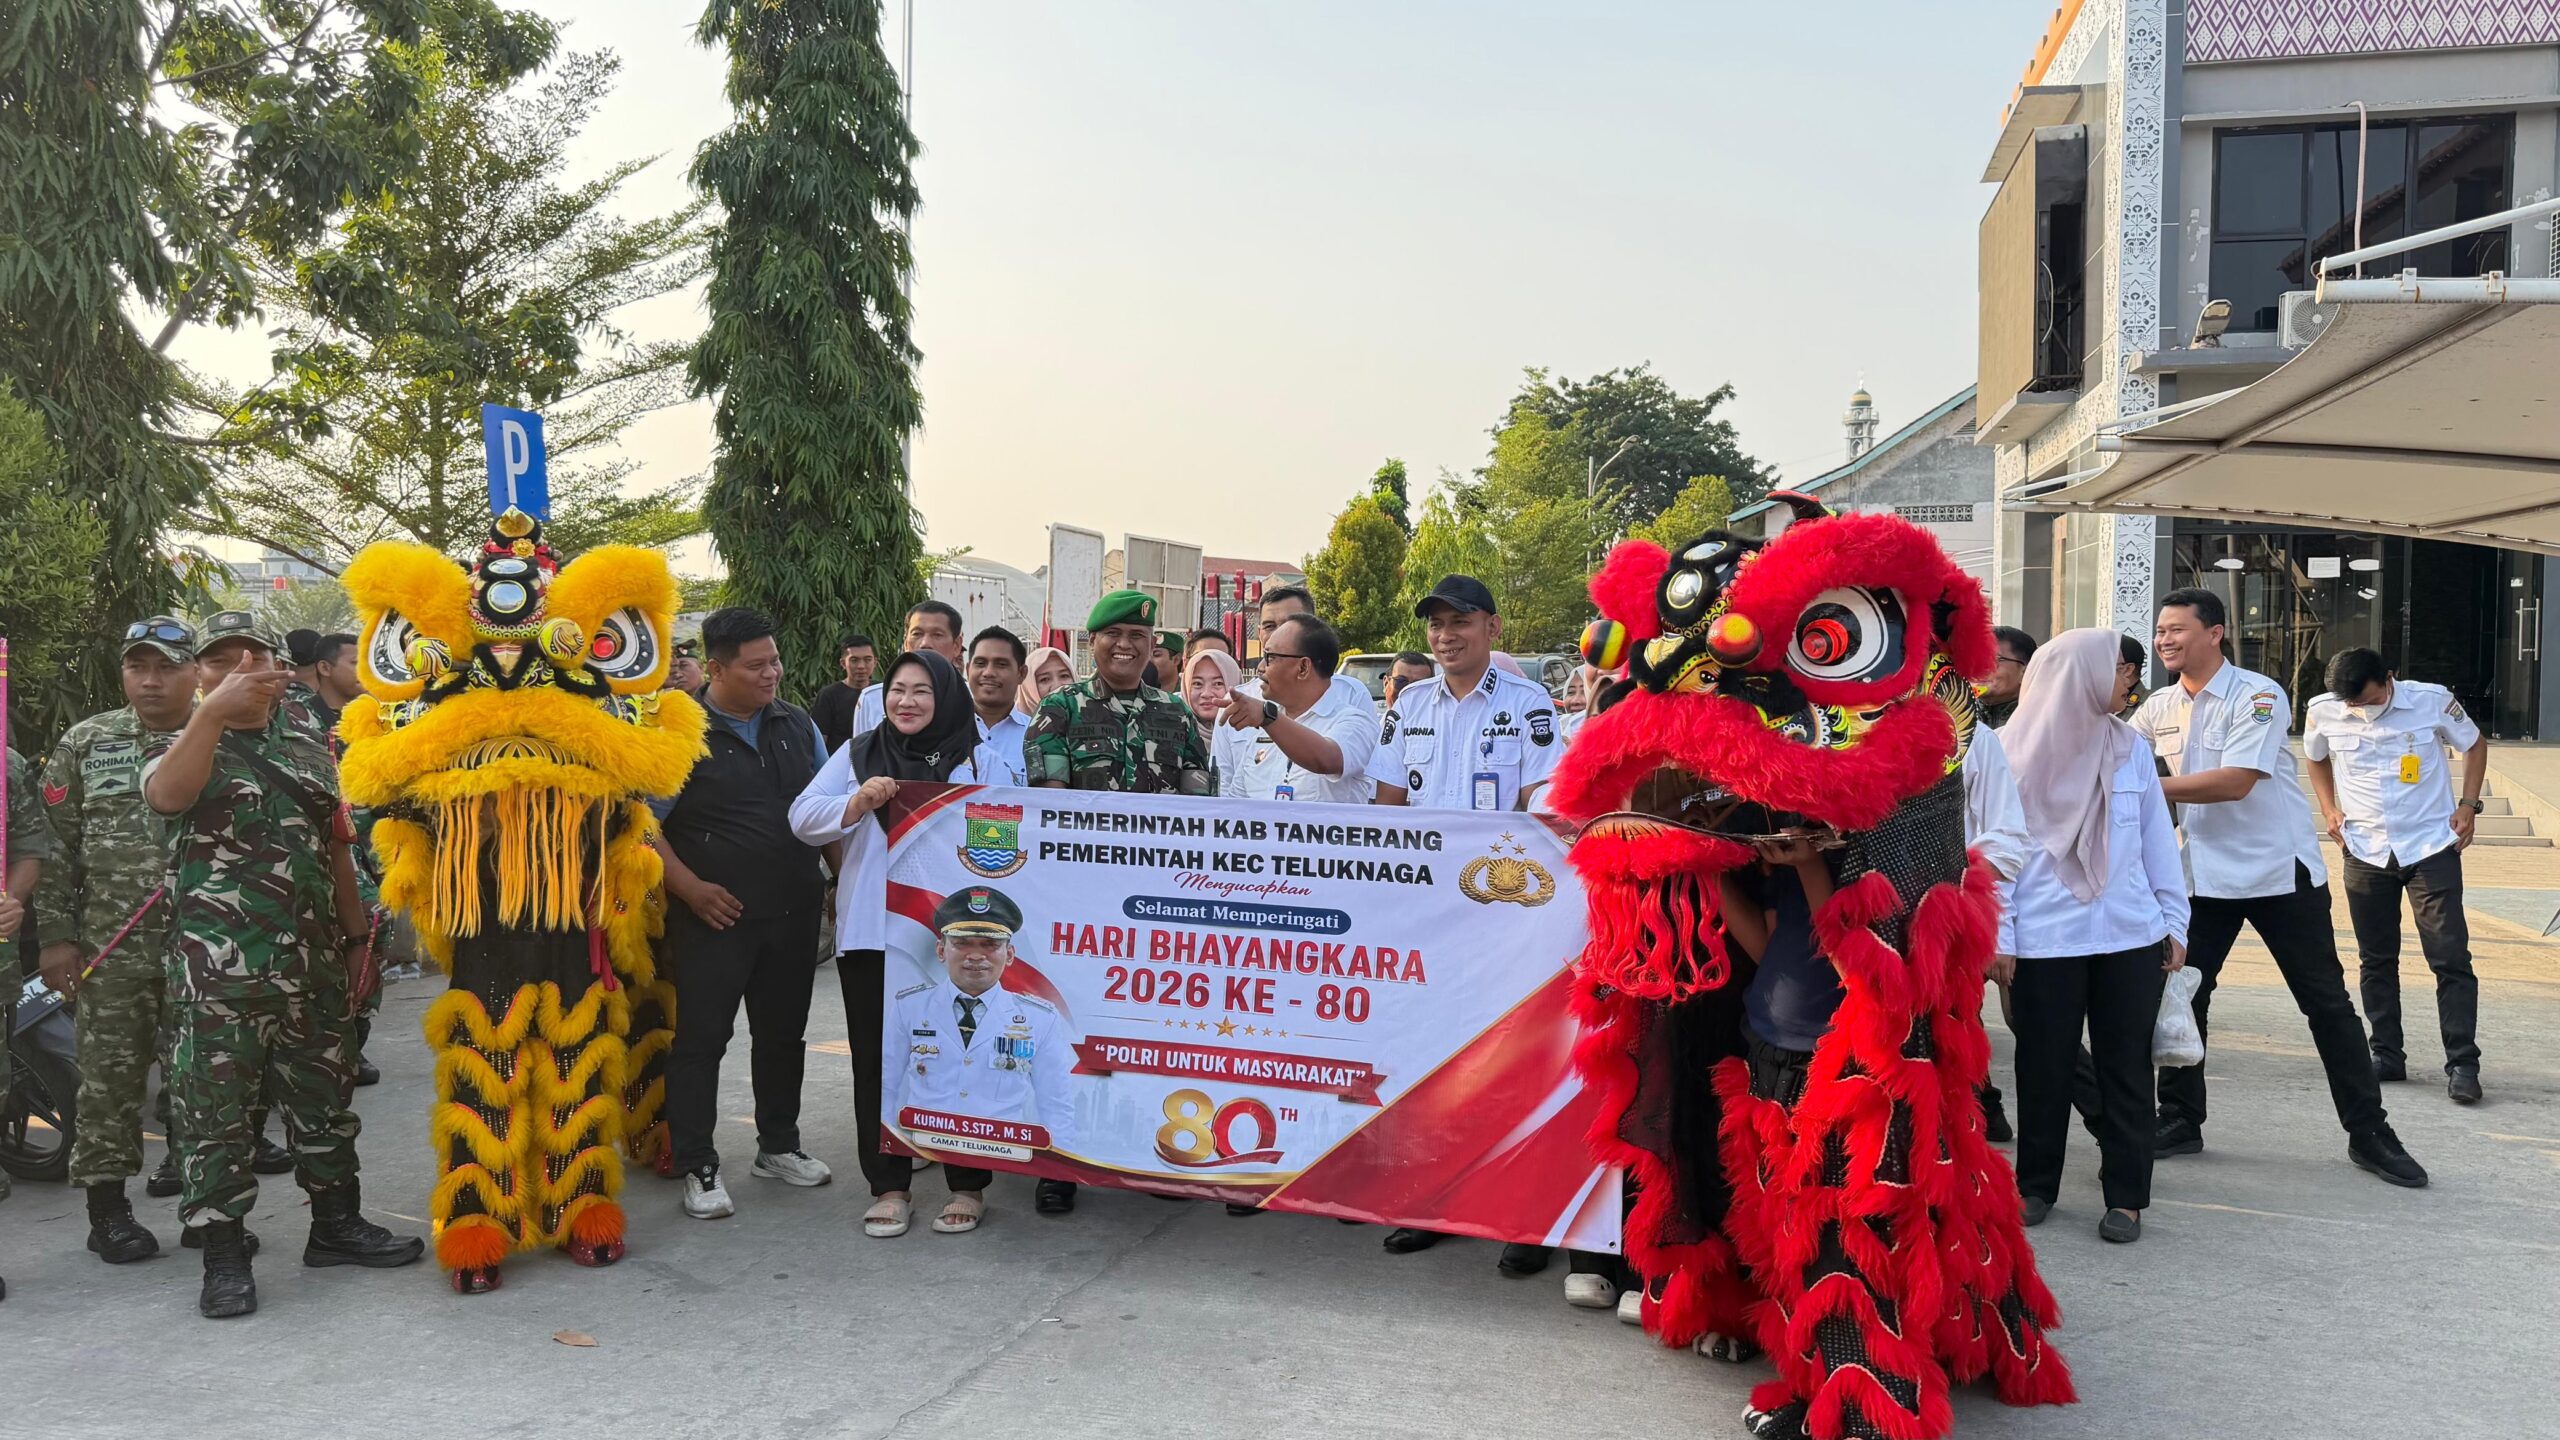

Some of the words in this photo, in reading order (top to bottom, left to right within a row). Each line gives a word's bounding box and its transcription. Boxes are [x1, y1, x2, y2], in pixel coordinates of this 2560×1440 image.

[502, 420, 529, 504] P
[1149, 729, 1168, 738] TNI
[1482, 727, 1521, 737] CAMAT
[1040, 809, 1205, 837] PEMERINTAH
[1213, 818, 1267, 842] KAB
[1274, 822, 1443, 852] TANGERANG
[1039, 841, 1204, 871] PEMERINTAH
[1213, 852, 1265, 874] KEC
[1271, 855, 1434, 886] TELUKNAGA
[1174, 871, 1312, 900] Mengucapkan
[1135, 900, 1207, 919] Selamat
[1212, 906, 1339, 931] Memperingati
[1050, 921, 1137, 960] HARI
[1149, 929, 1427, 985] BHAYANGKARA
[1103, 965, 1210, 1009] 2026
[1223, 976, 1277, 1015] KE
[1288, 998, 1303, 1008] -
[1315, 983, 1371, 1024] 80
[1095, 1043, 1159, 1067] “POLRI
[1165, 1050, 1227, 1073] UNTUK
[1233, 1056, 1366, 1087] MASYARAKAT”
[913, 1112, 959, 1133] KURNIA,
[962, 1120, 1000, 1139] S.STP.,
[1003, 1127, 1017, 1140] M.
[1020, 1128, 1032, 1141] Si
[931, 1136, 959, 1148] CAMAT
[962, 1141, 1012, 1155] TELUKNAGA
[1155, 1088, 1277, 1164] 80
[1279, 1107, 1298, 1122] TH
